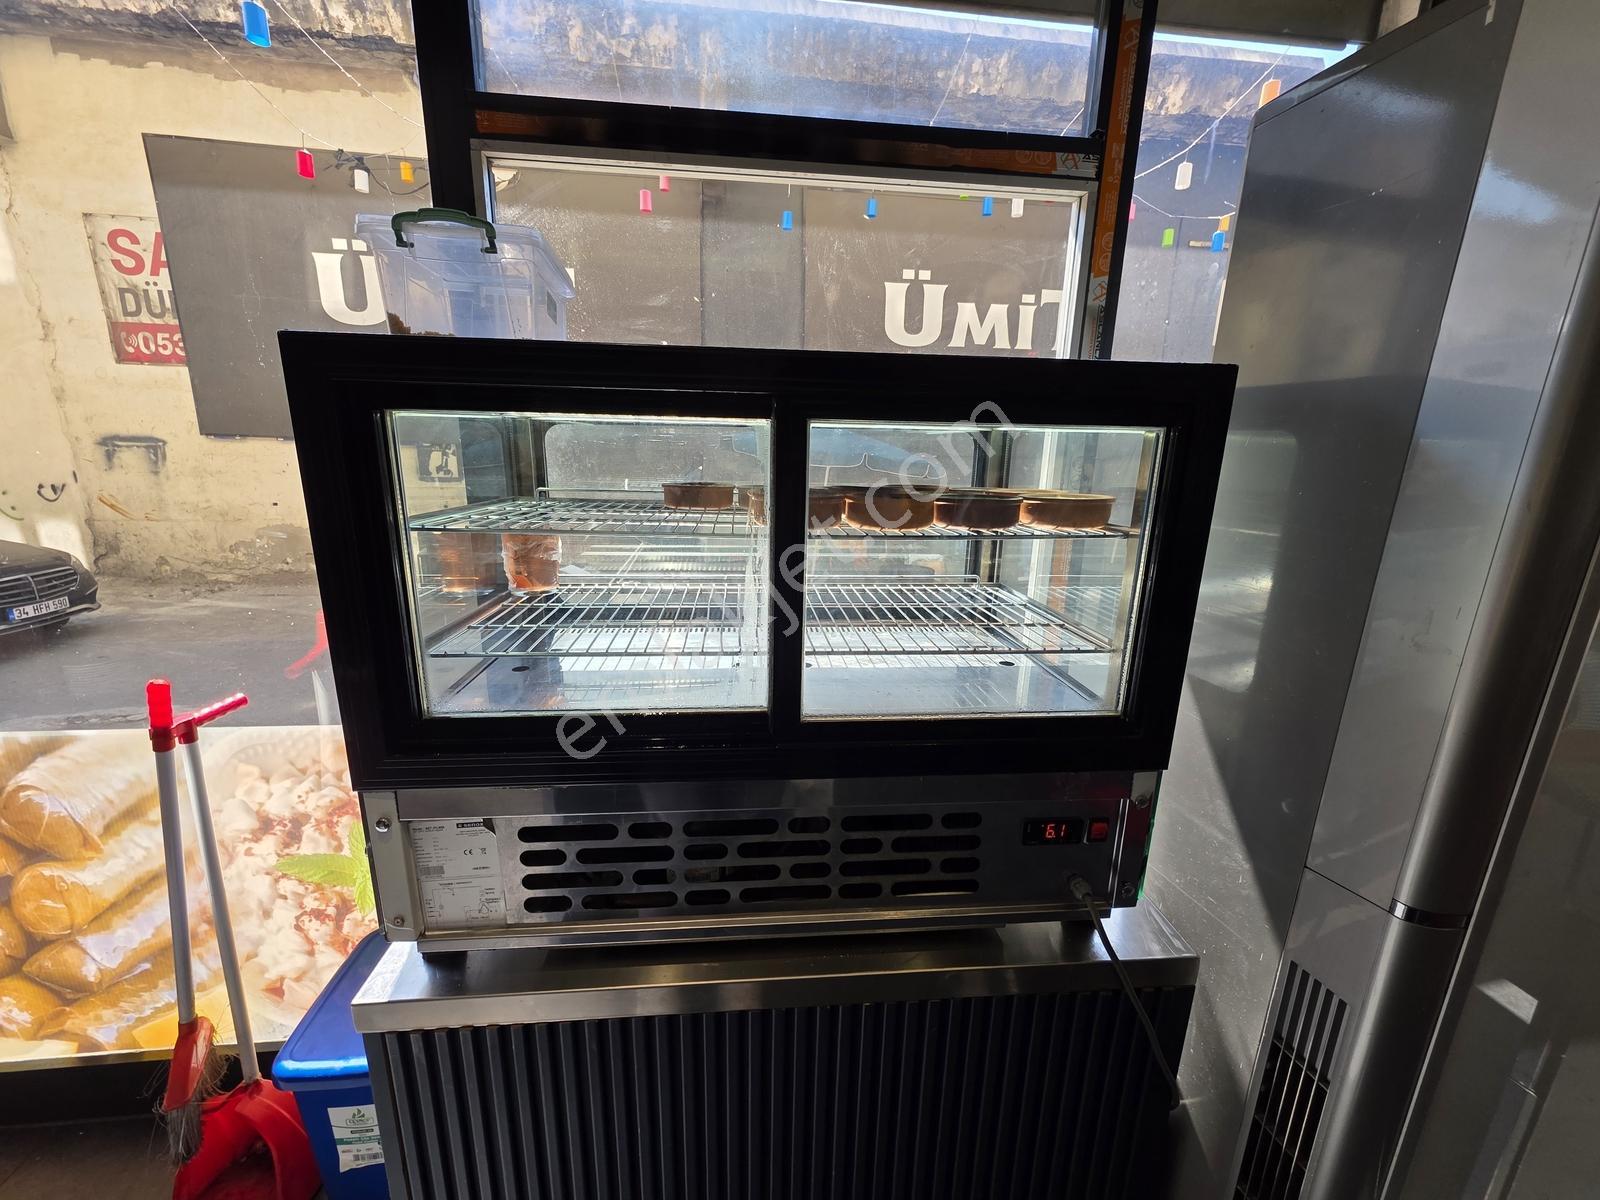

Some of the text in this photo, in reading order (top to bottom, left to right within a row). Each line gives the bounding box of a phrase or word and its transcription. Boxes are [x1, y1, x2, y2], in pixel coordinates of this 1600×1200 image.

[117, 280, 178, 320] DÜ
[16, 608, 29, 618] 34
[32, 602, 51, 615] HFH
[52, 598, 68, 609] 590
